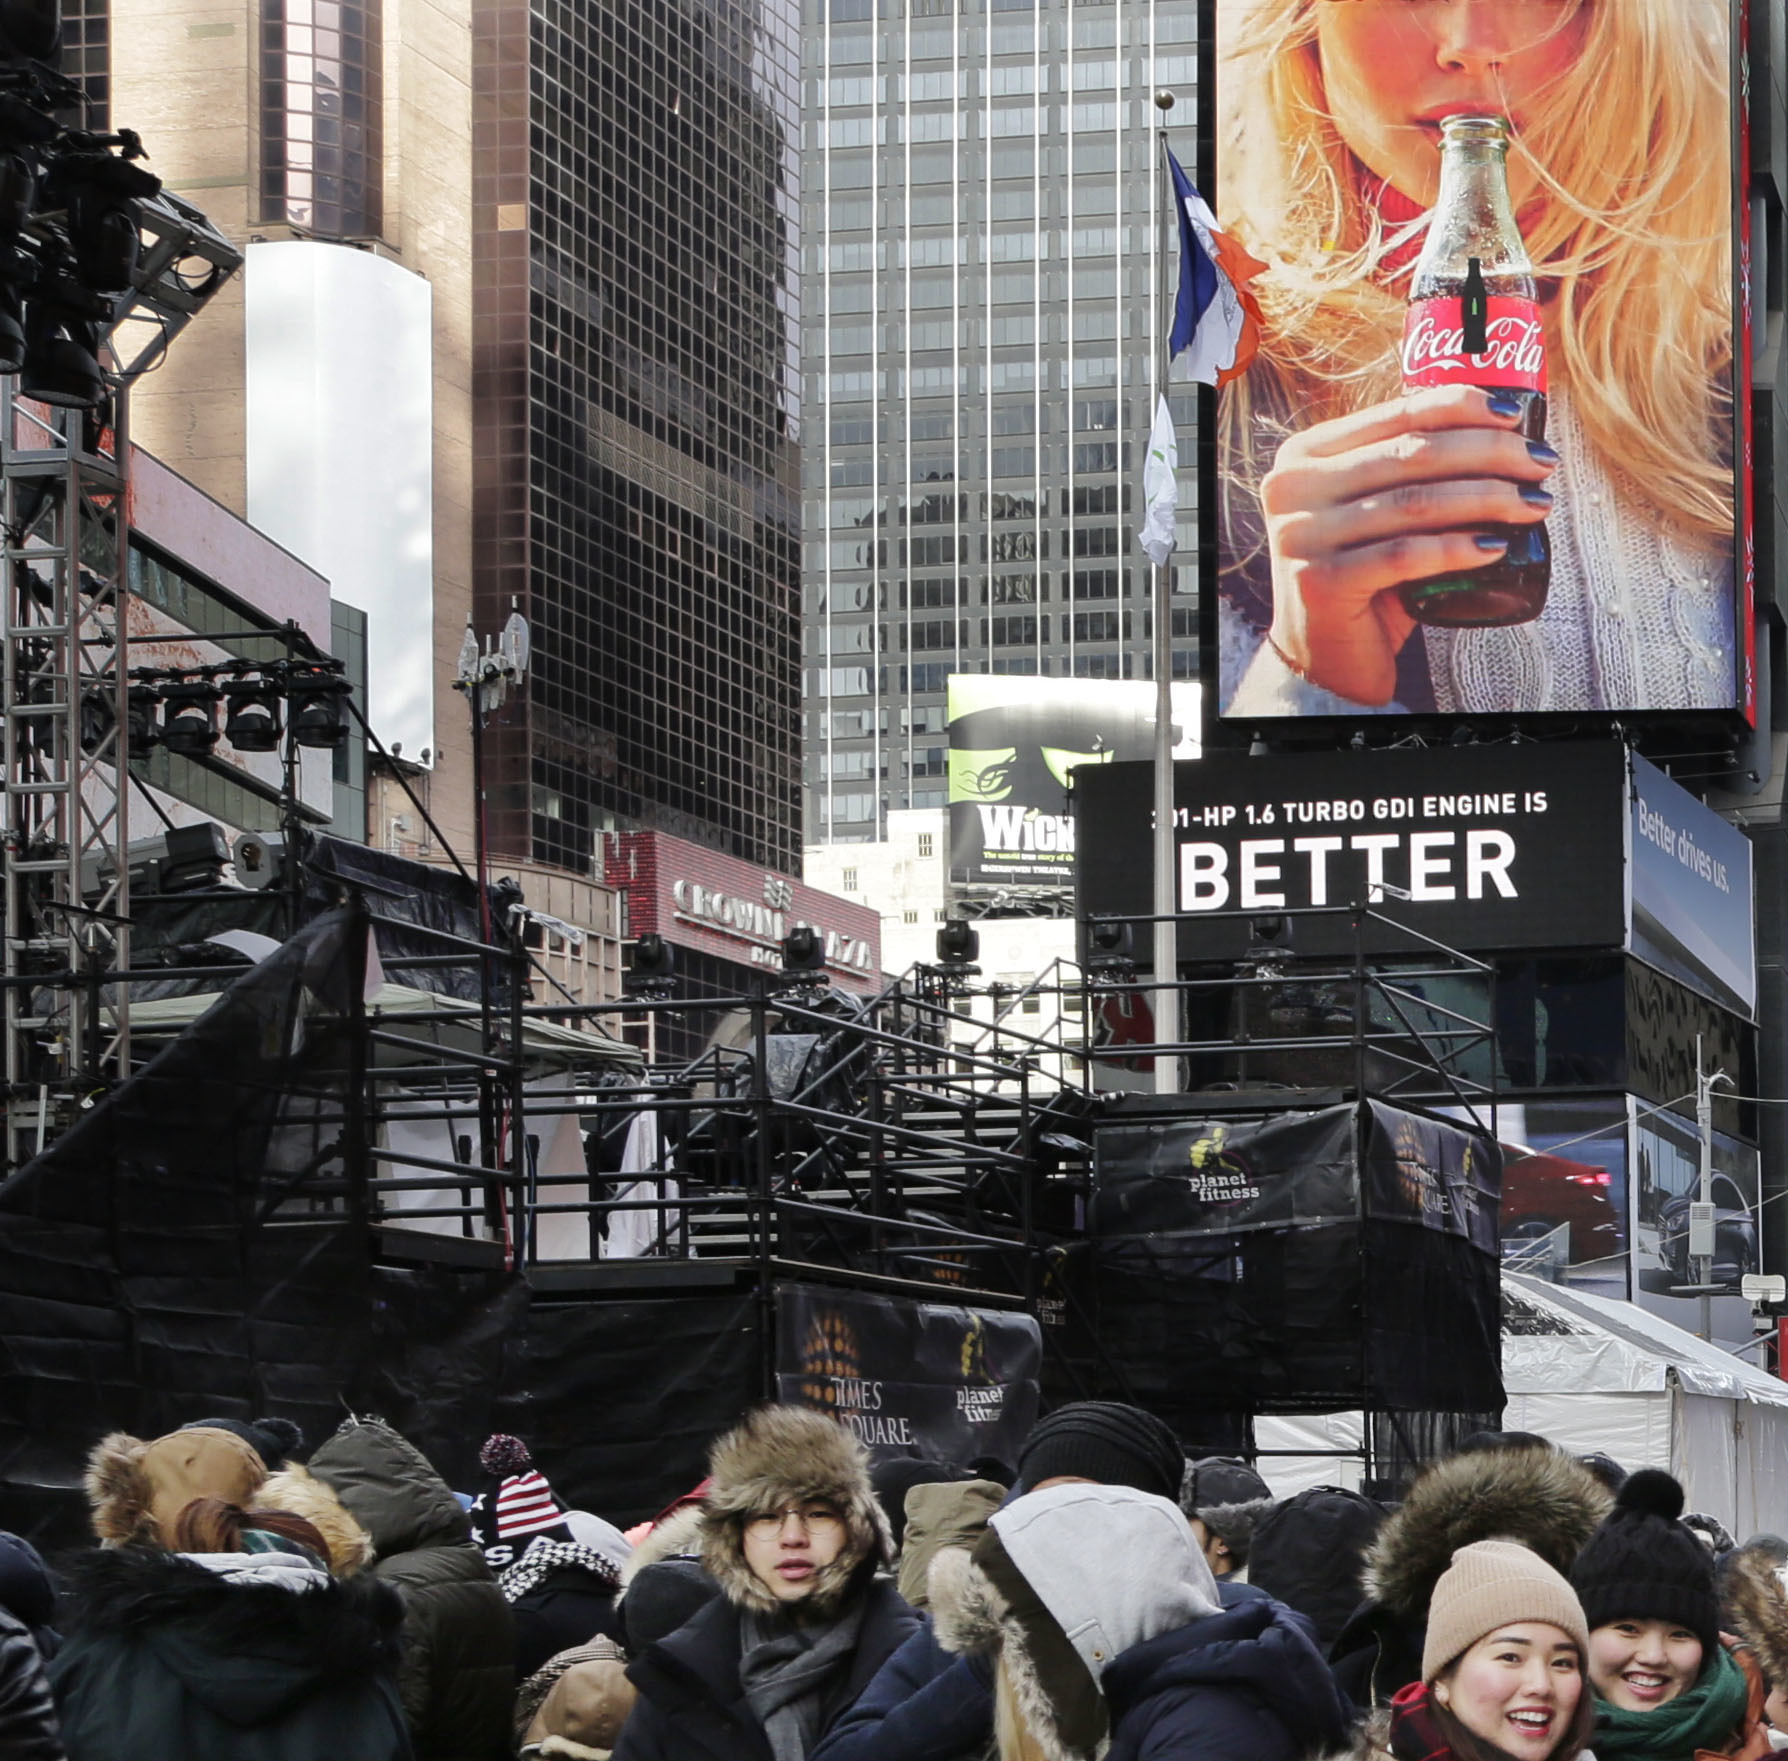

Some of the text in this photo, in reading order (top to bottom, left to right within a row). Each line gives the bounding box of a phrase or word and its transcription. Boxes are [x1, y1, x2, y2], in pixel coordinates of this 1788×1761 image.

[1245, 803, 1276, 825] 1.6
[1283, 800, 1364, 824] TURBO
[1372, 797, 1415, 820] GDI
[1423, 794, 1516, 818] ENGINE
[1525, 792, 1548, 813] IS
[1638, 796, 1730, 894] Better drives us.
[1180, 829, 1519, 912] BETTER
[1188, 1171, 1248, 1193] planet
[1199, 1185, 1260, 1203] fitness
[830, 1377, 883, 1410] TIMES
[956, 1385, 1005, 1411] planet
